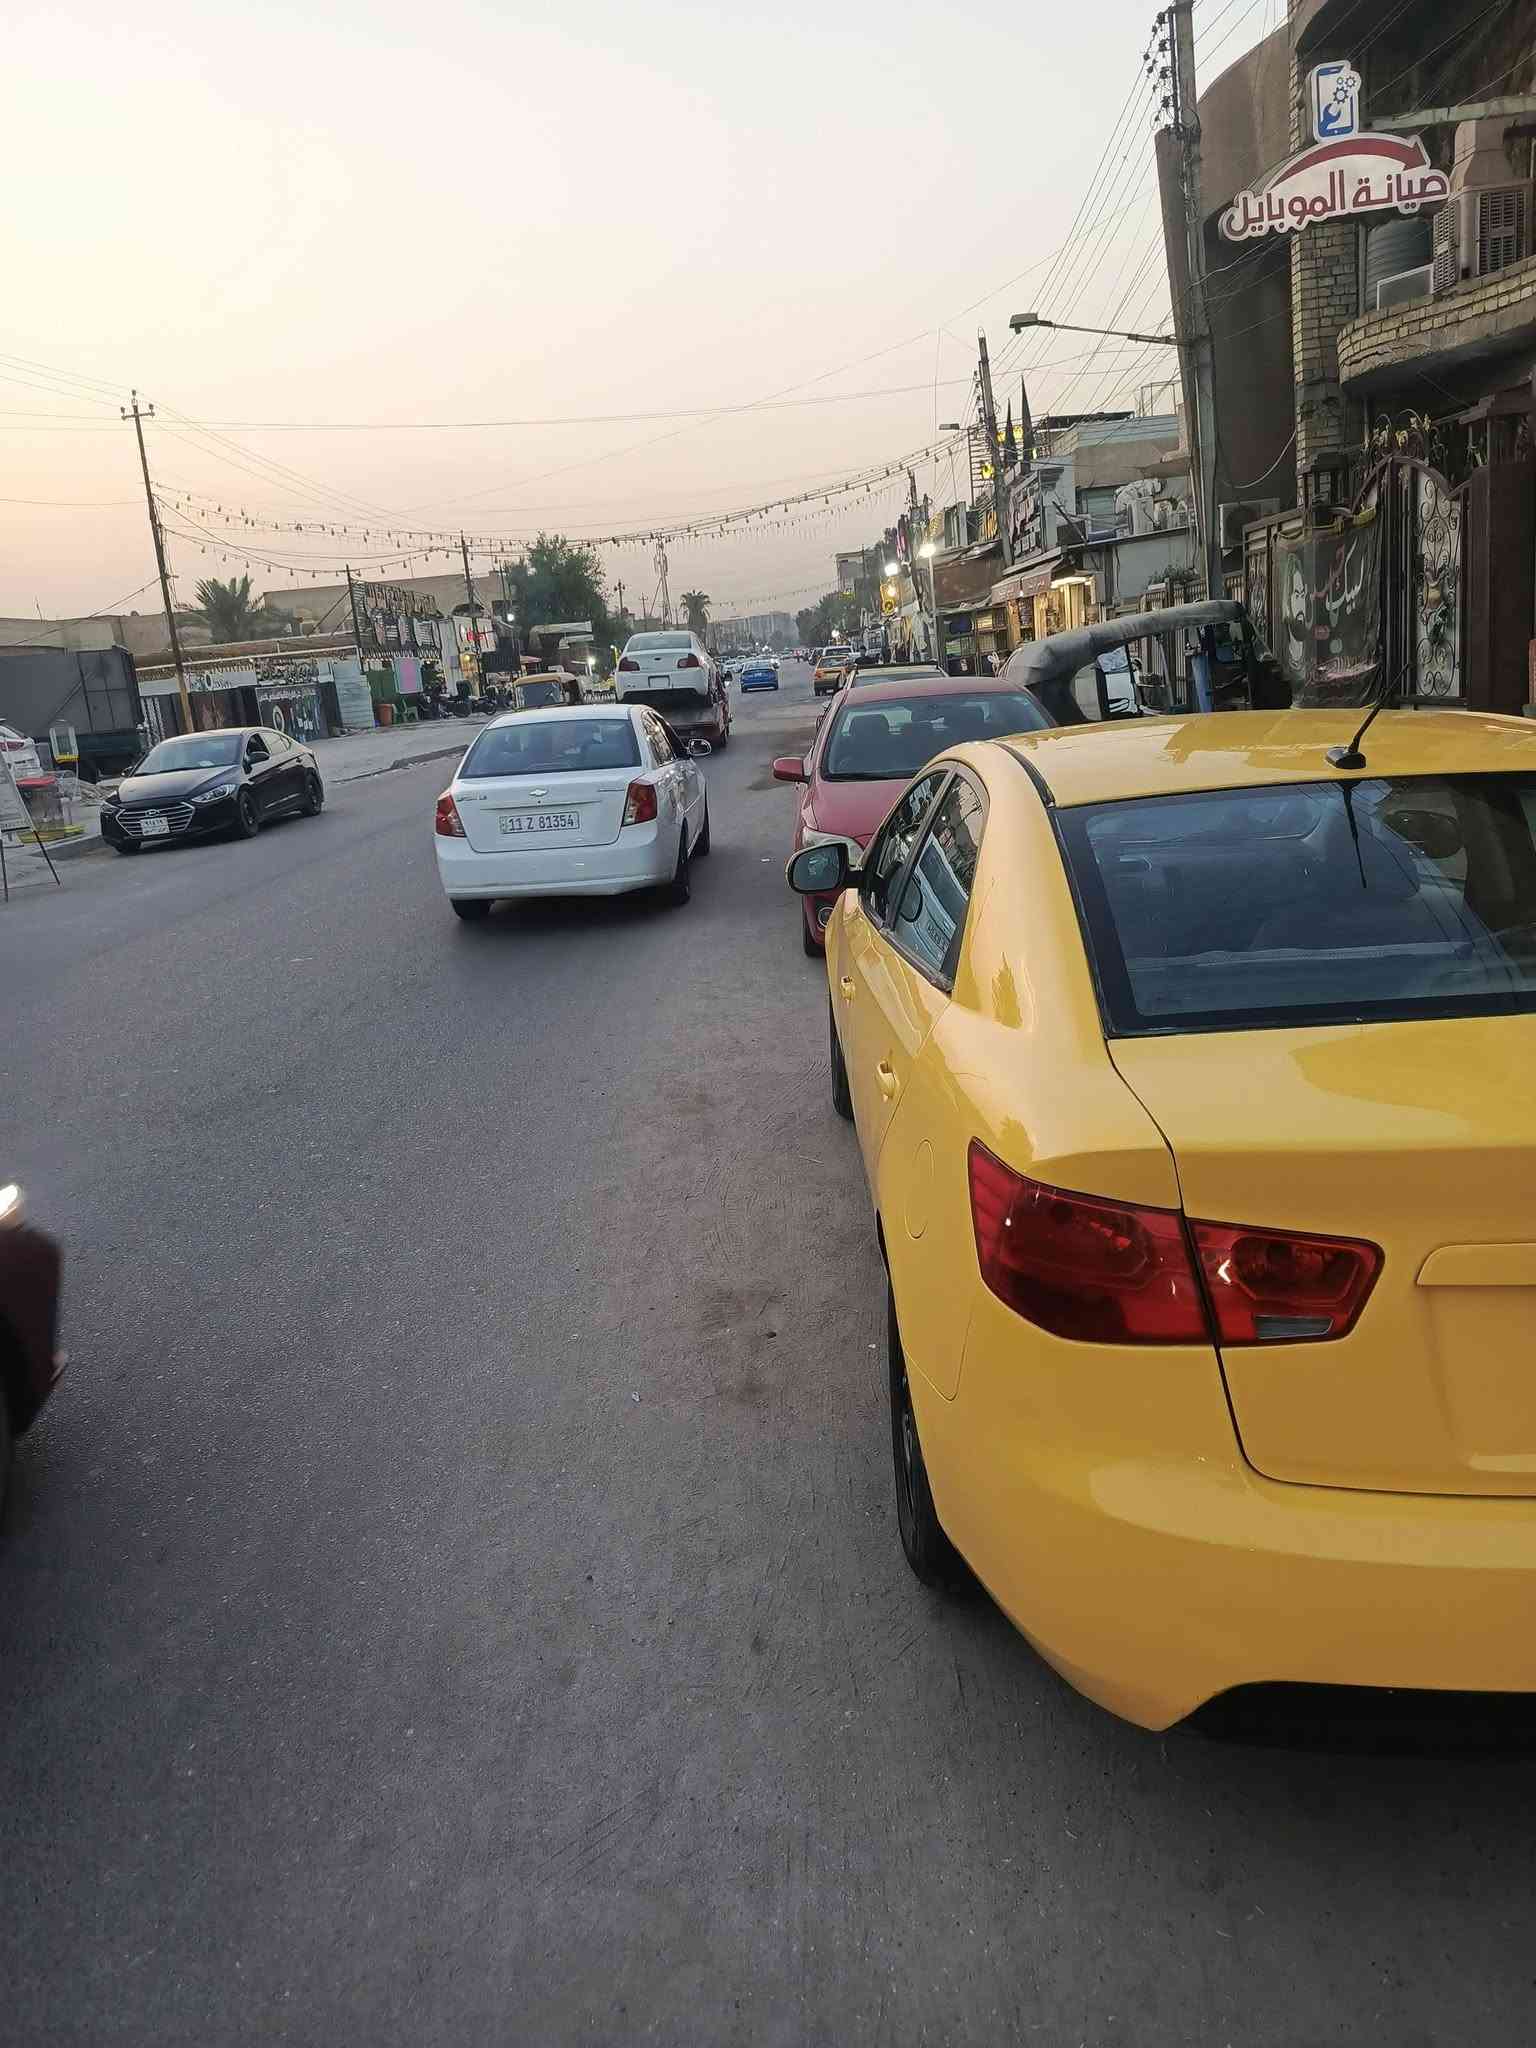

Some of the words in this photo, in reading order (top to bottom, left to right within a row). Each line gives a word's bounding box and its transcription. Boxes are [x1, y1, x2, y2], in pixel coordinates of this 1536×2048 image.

[1226, 169, 1345, 236] الموبايل
[1352, 173, 1448, 209] صيانة
[509, 818, 523, 831] 11
[526, 817, 534, 830] Z
[538, 814, 574, 829] 81354
